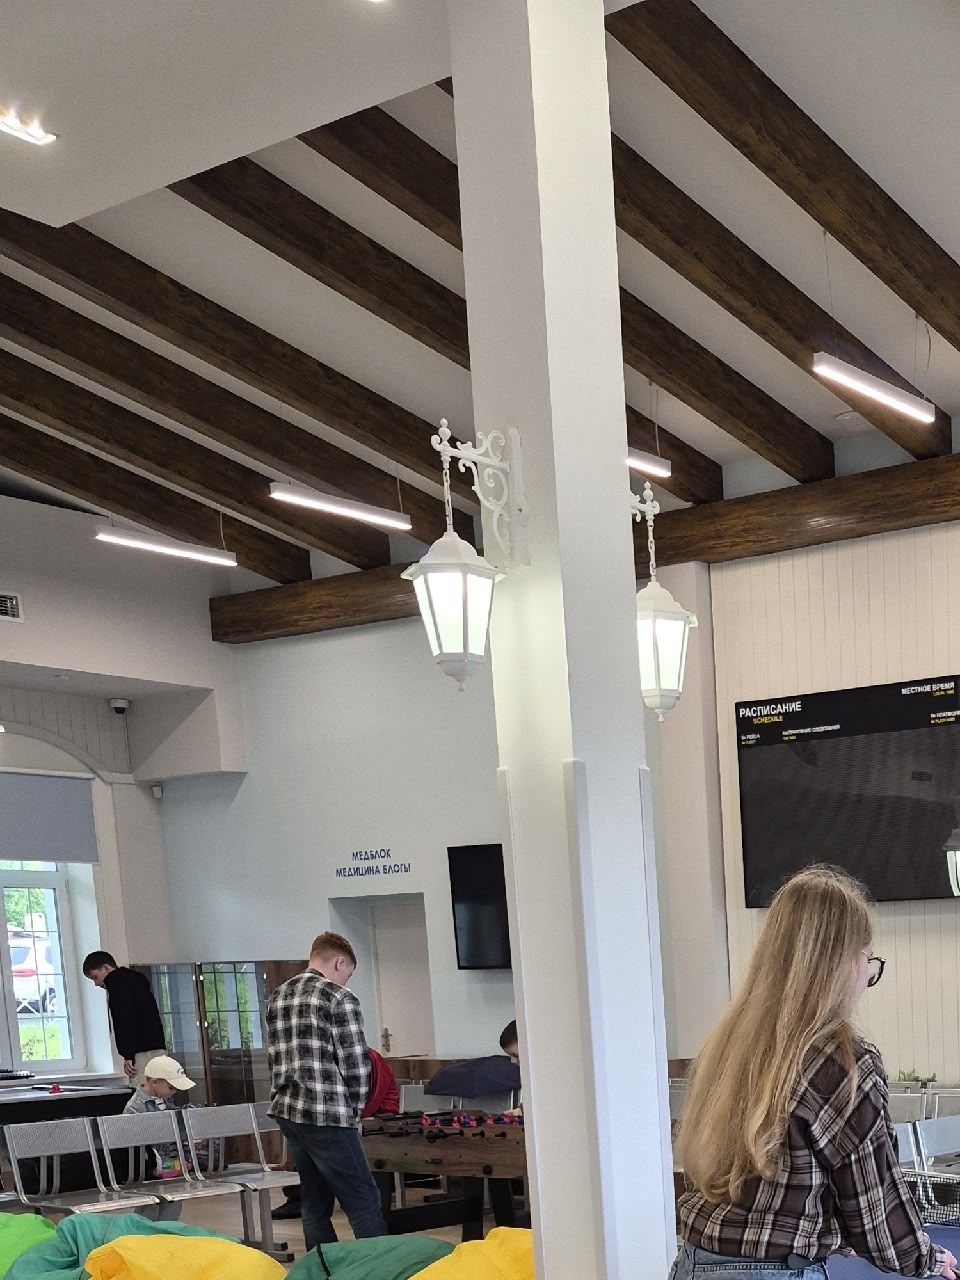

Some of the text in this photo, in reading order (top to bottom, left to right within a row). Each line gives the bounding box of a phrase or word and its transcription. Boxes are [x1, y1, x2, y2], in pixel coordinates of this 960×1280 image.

[901, 681, 955, 695] МЕСТНОЕ ВРЕМЯ
[740, 701, 802, 718] РАСПИСАНИЕ
[752, 715, 784, 725] SCHEDULE
[352, 848, 391, 861] МЕДБЛОК
[336, 862, 411, 878] МЕДИЦИНА БЛОГЫ
